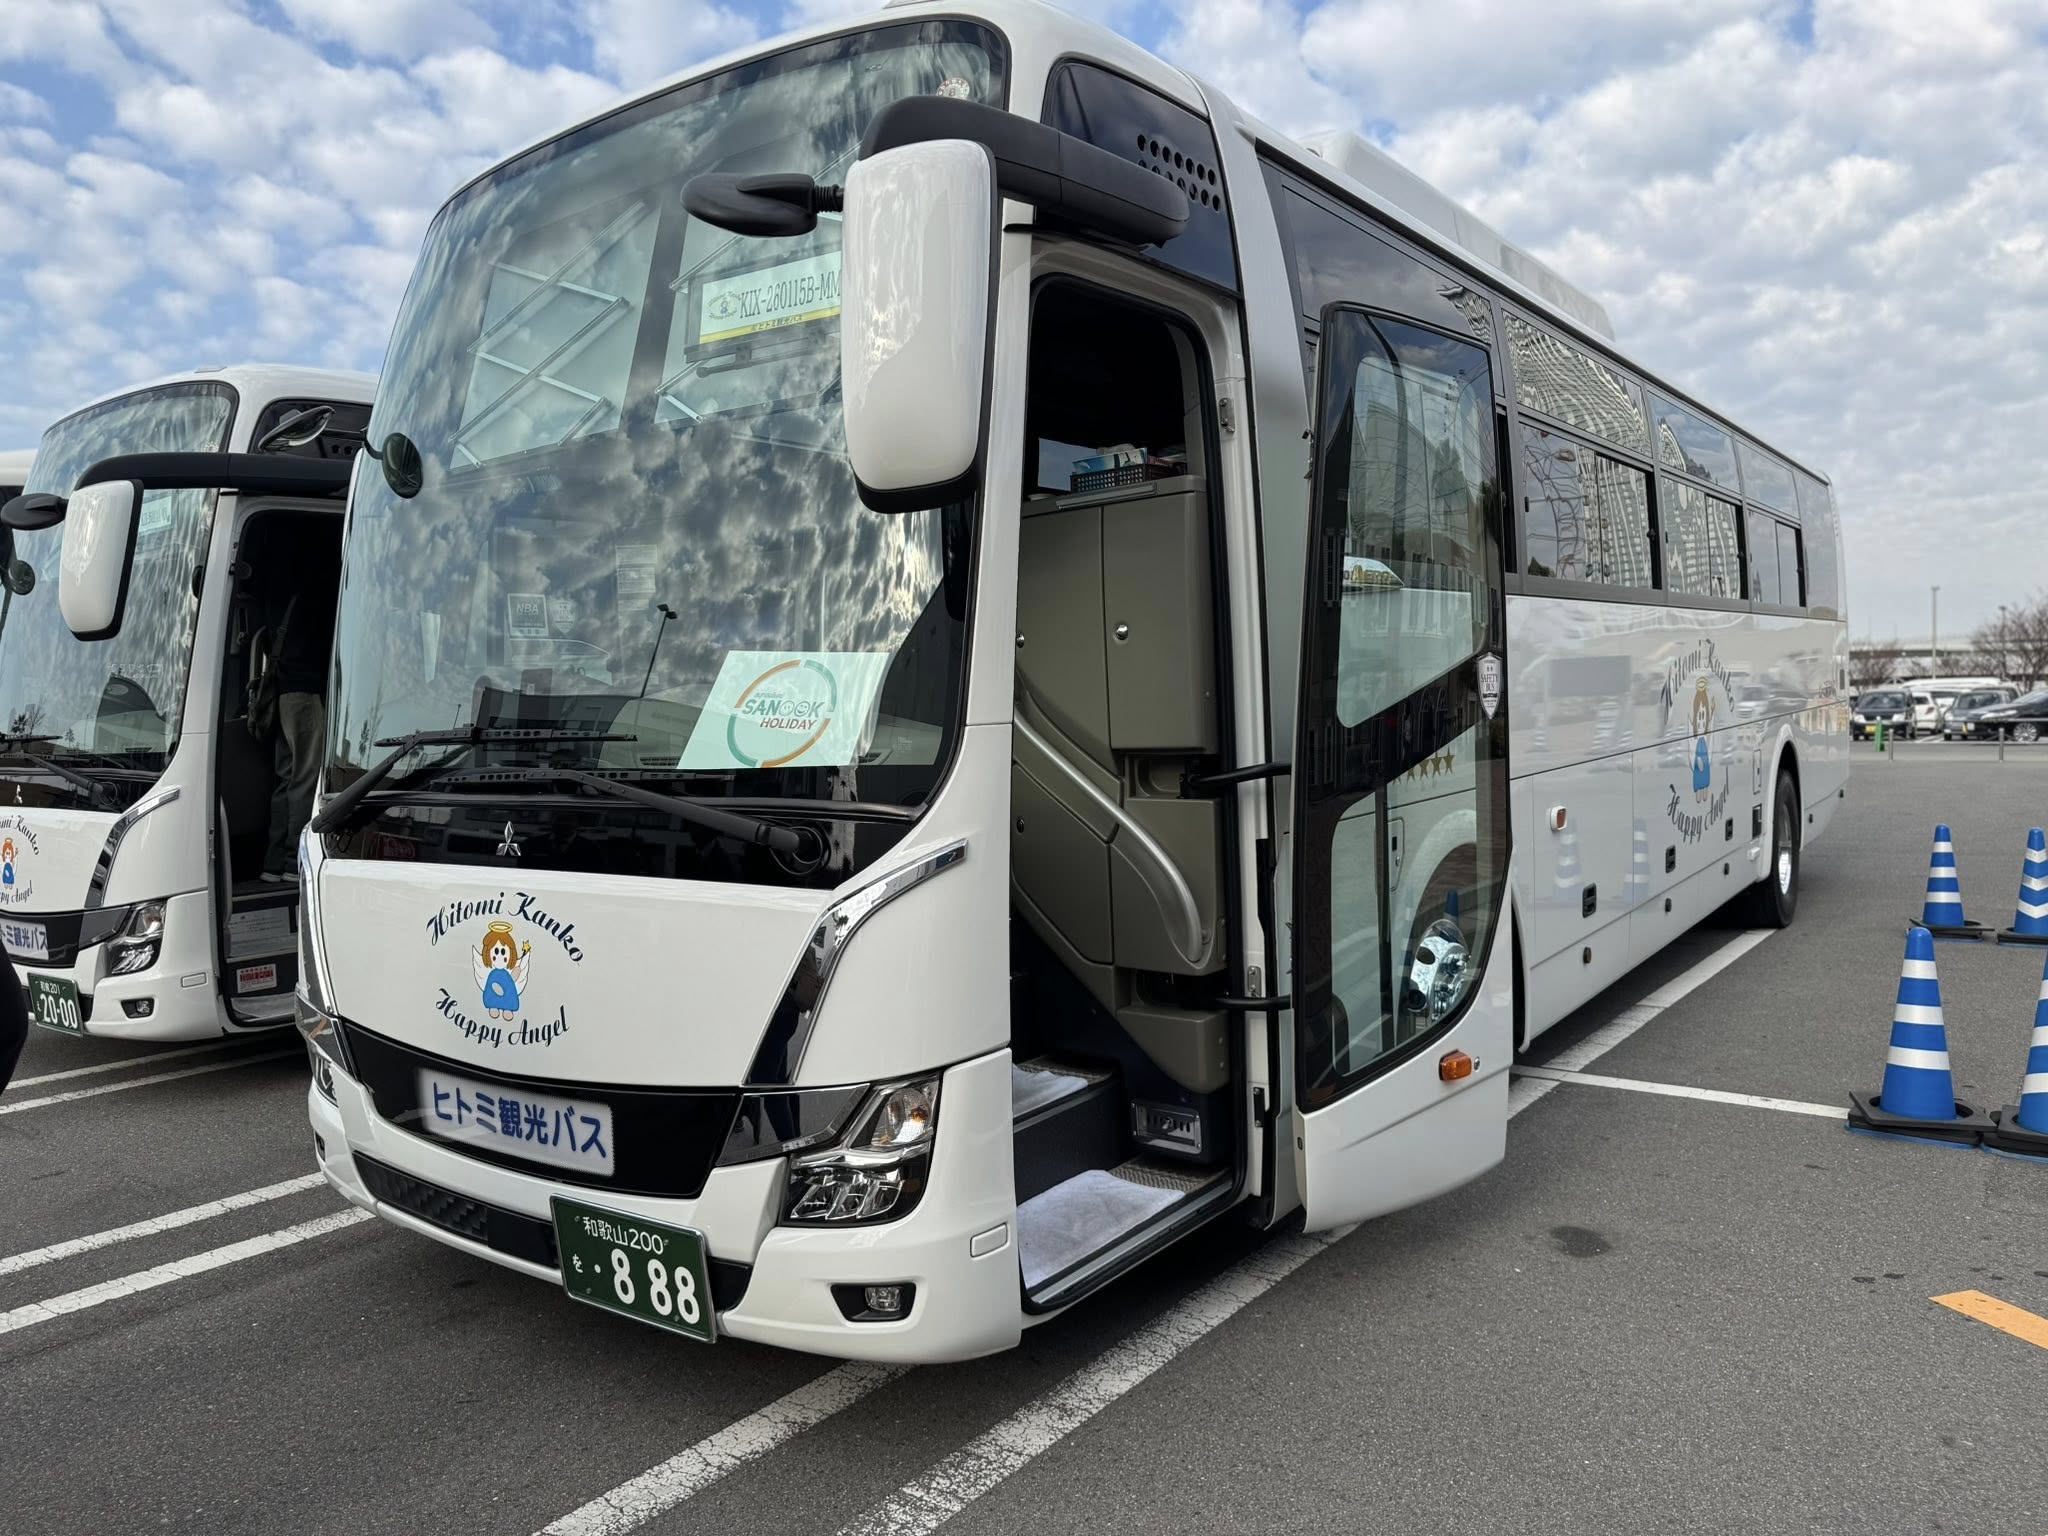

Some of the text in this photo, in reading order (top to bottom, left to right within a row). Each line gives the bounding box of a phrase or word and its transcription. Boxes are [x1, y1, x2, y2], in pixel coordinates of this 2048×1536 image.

[742, 699, 824, 718] SANOOK
[760, 717, 817, 730] HOLIDAY
[1667, 783, 1702, 844] Happy
[426, 891, 583, 964] Hitomi Kanko
[435, 987, 571, 1048] Happy Angel
[433, 1082, 607, 1158] ヒトミ観光バス
